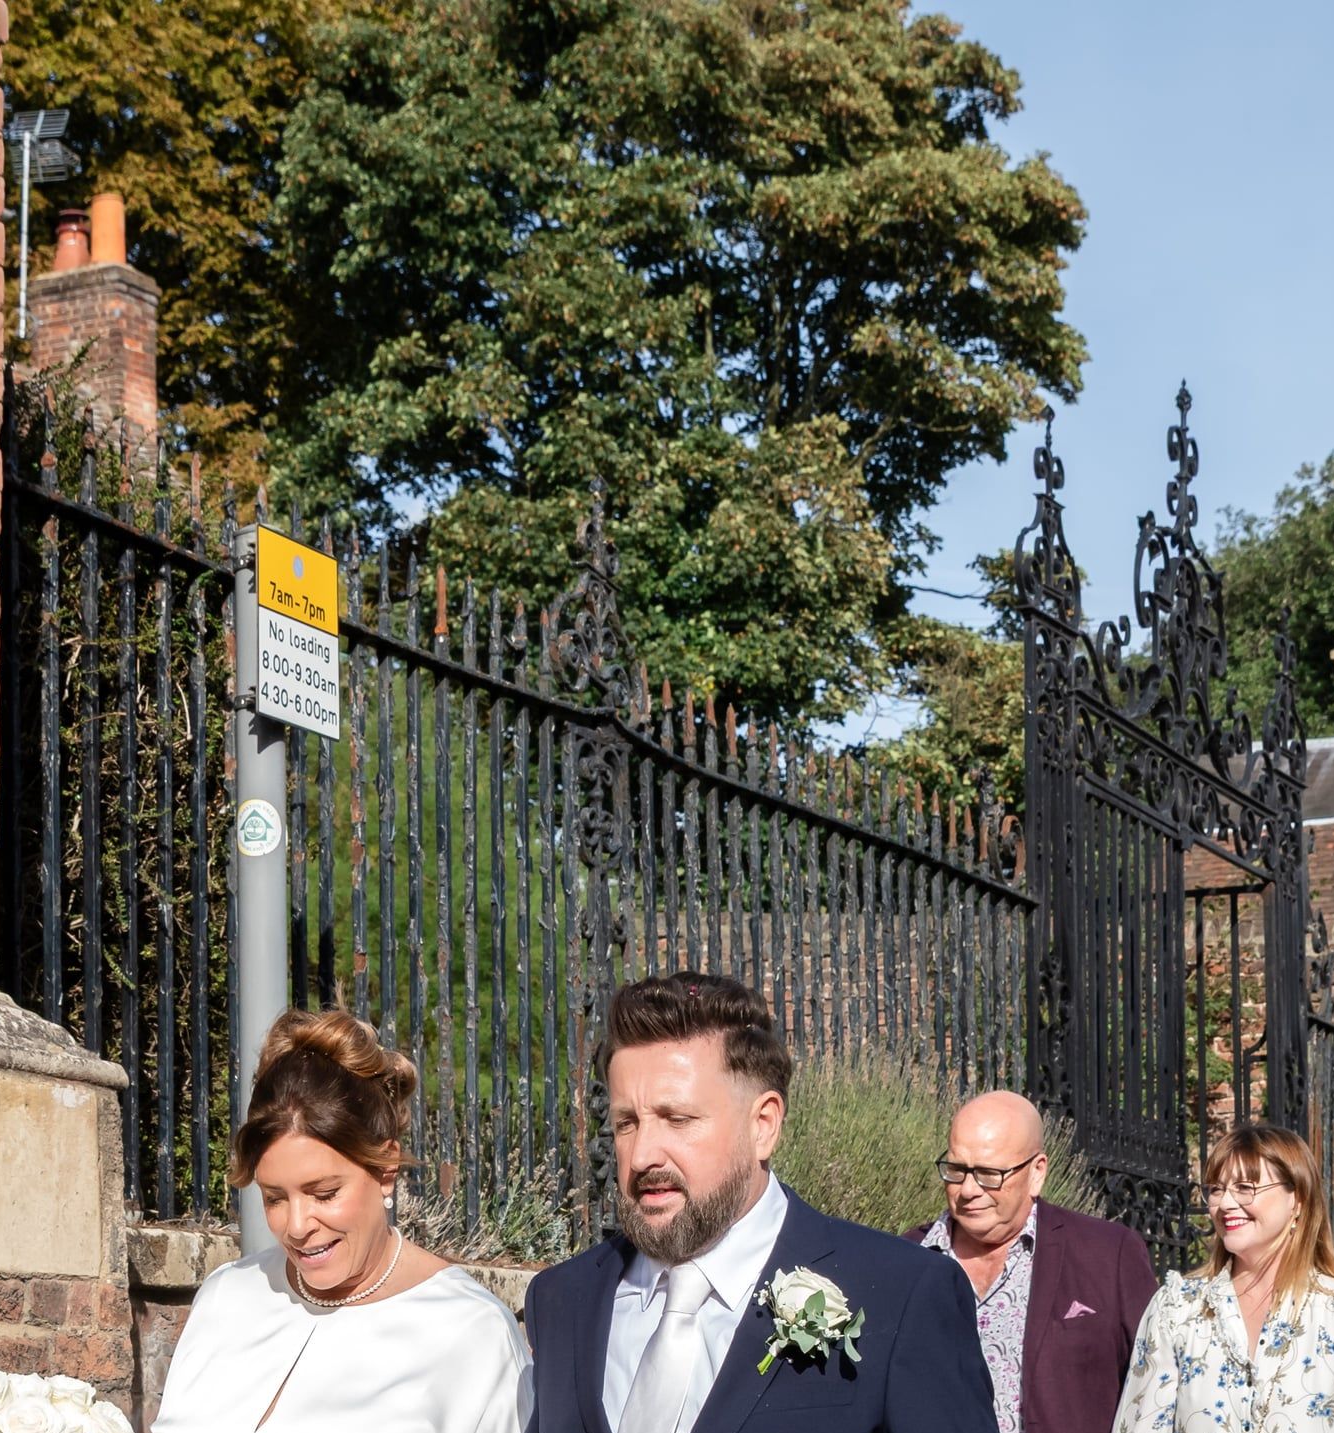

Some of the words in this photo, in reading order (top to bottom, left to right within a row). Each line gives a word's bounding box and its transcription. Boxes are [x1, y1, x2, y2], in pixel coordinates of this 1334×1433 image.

[269, 620, 285, 642] No
[289, 628, 331, 664] loading
[262, 650, 337, 697] 8.00-9.30am
[261, 681, 338, 726] 4.30-6.00pm
